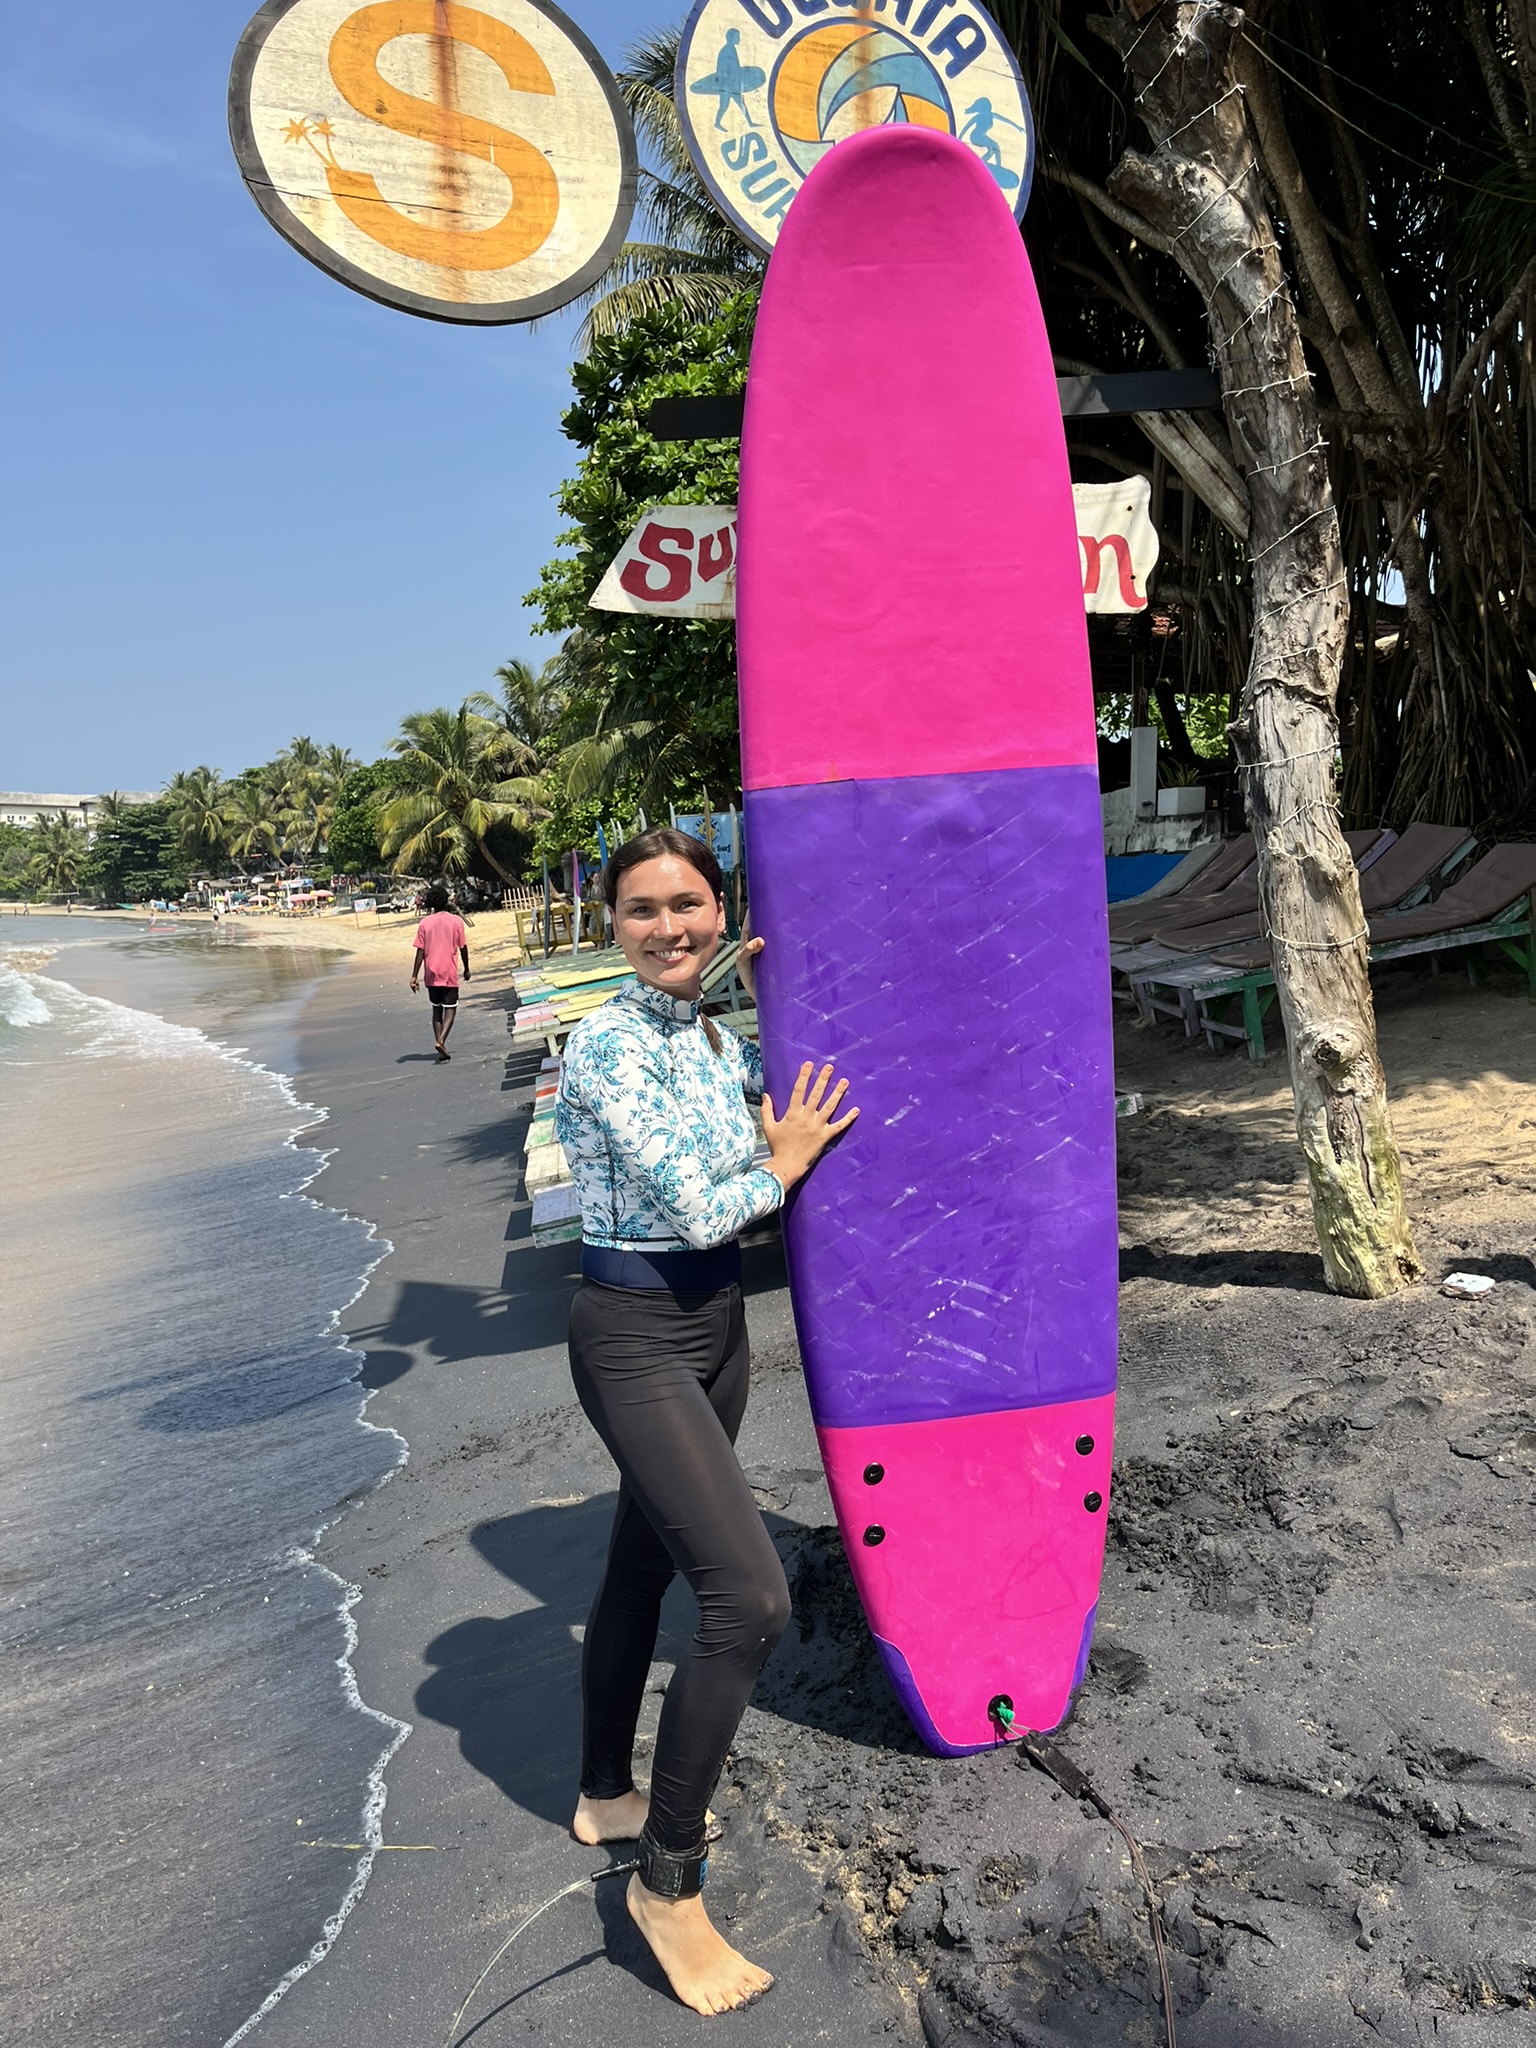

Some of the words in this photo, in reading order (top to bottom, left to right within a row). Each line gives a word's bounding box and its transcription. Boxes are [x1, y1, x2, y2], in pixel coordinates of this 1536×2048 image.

[738, 0, 987, 79] DTA
[324, 0, 560, 271] S
[619, 520, 737, 603] Su
